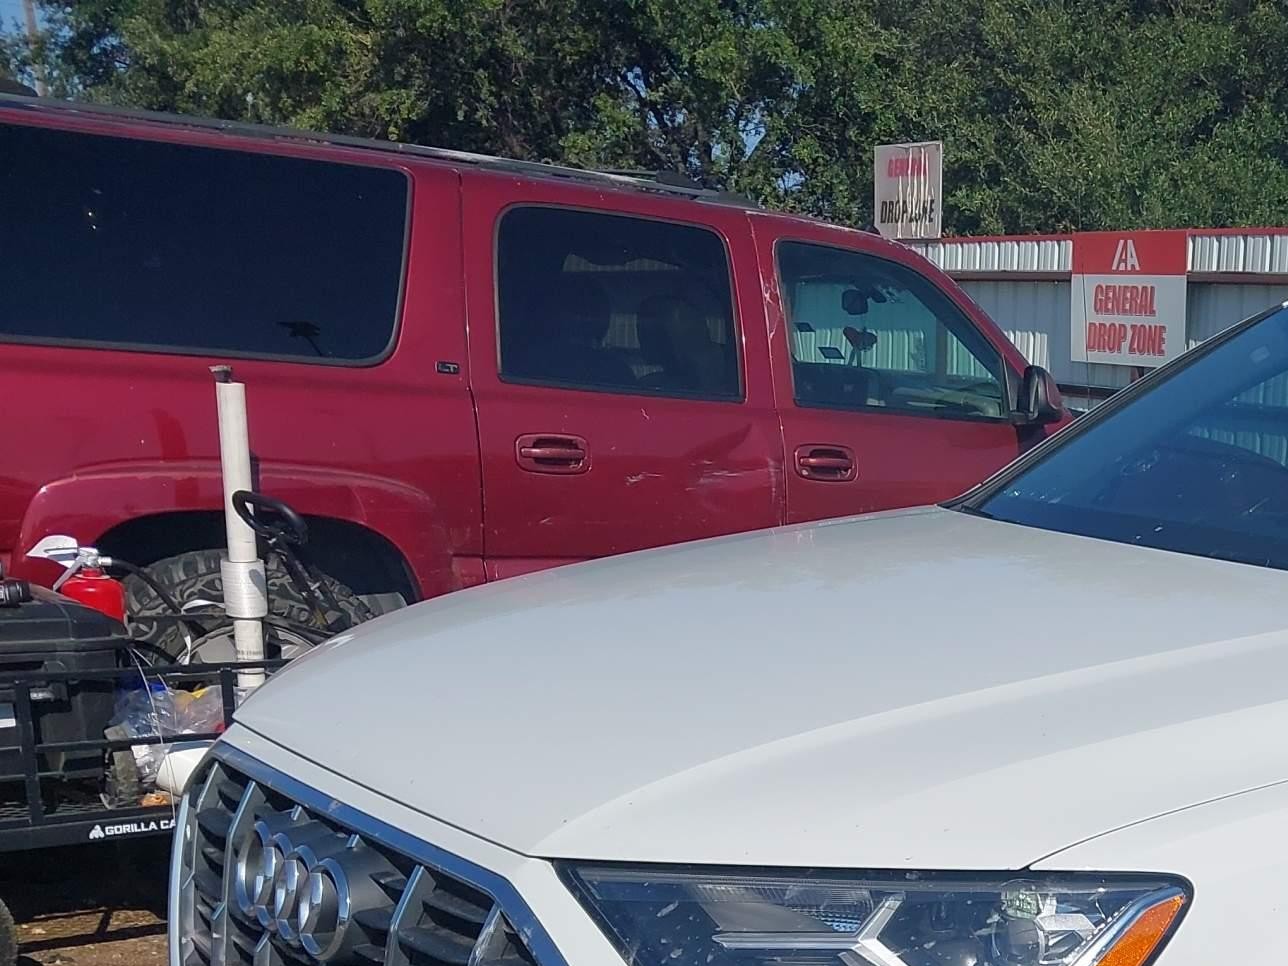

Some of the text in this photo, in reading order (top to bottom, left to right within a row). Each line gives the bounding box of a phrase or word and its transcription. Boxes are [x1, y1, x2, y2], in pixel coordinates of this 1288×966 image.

[880, 200, 908, 223] DROP
[1093, 284, 1156, 316] GENERAL
[1087, 322, 1166, 356] DROP ZONE
[105, 821, 157, 835] GORILLA
